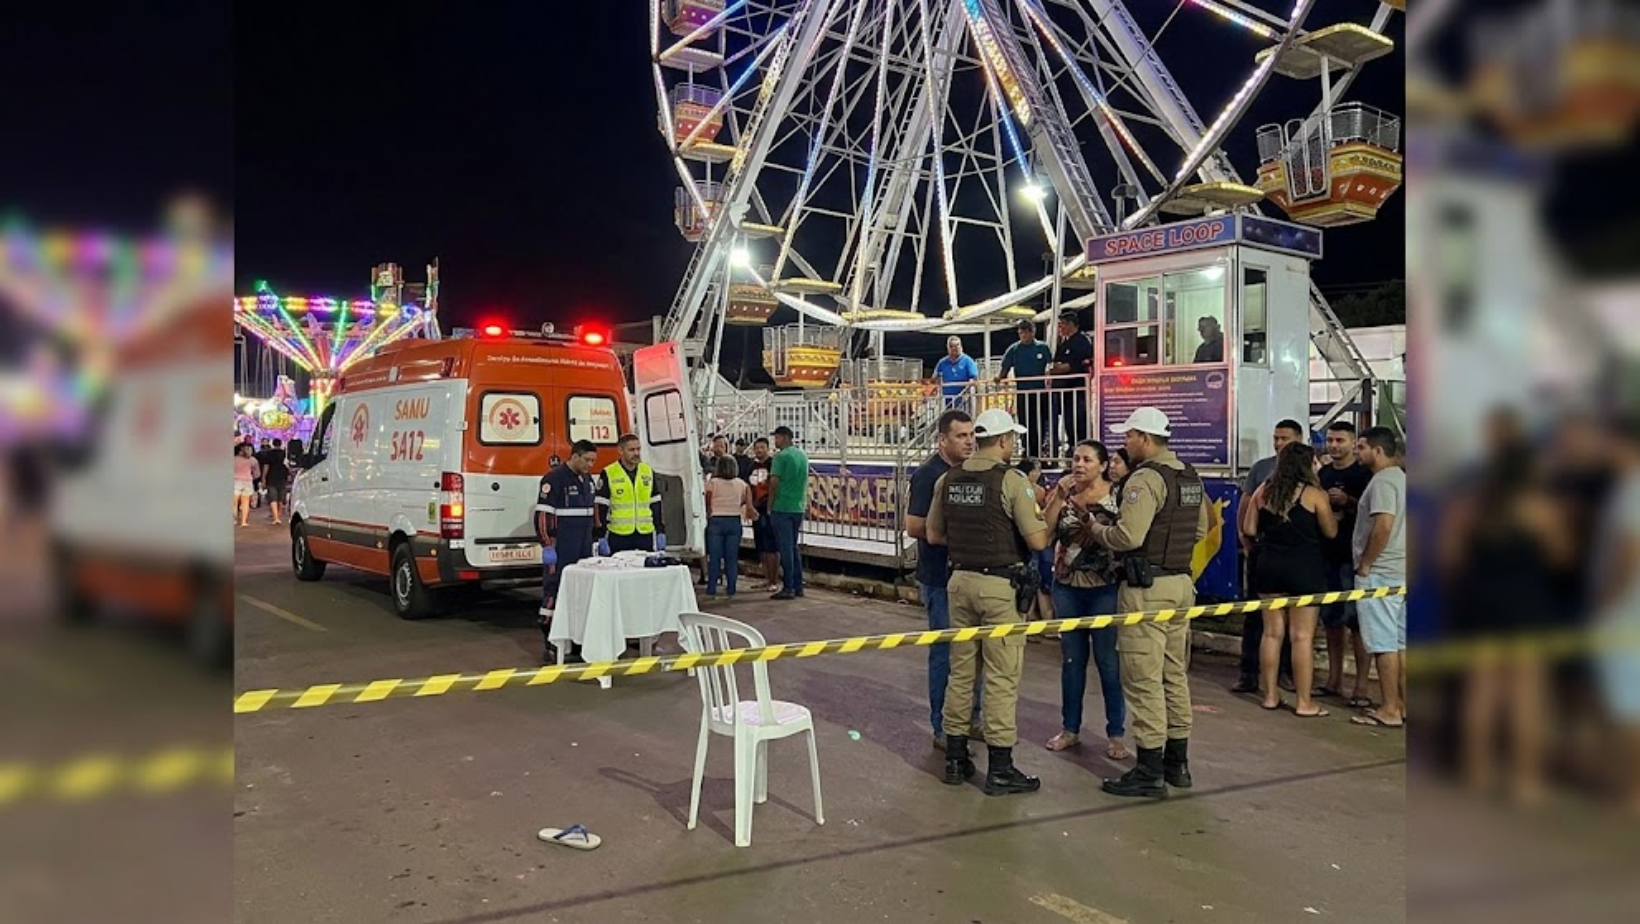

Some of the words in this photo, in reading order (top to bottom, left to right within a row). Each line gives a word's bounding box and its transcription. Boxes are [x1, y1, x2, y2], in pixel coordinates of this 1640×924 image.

[1105, 230, 1165, 257] SPACE
[1169, 221, 1225, 248] LOOP
[394, 397, 430, 421] SAMU
